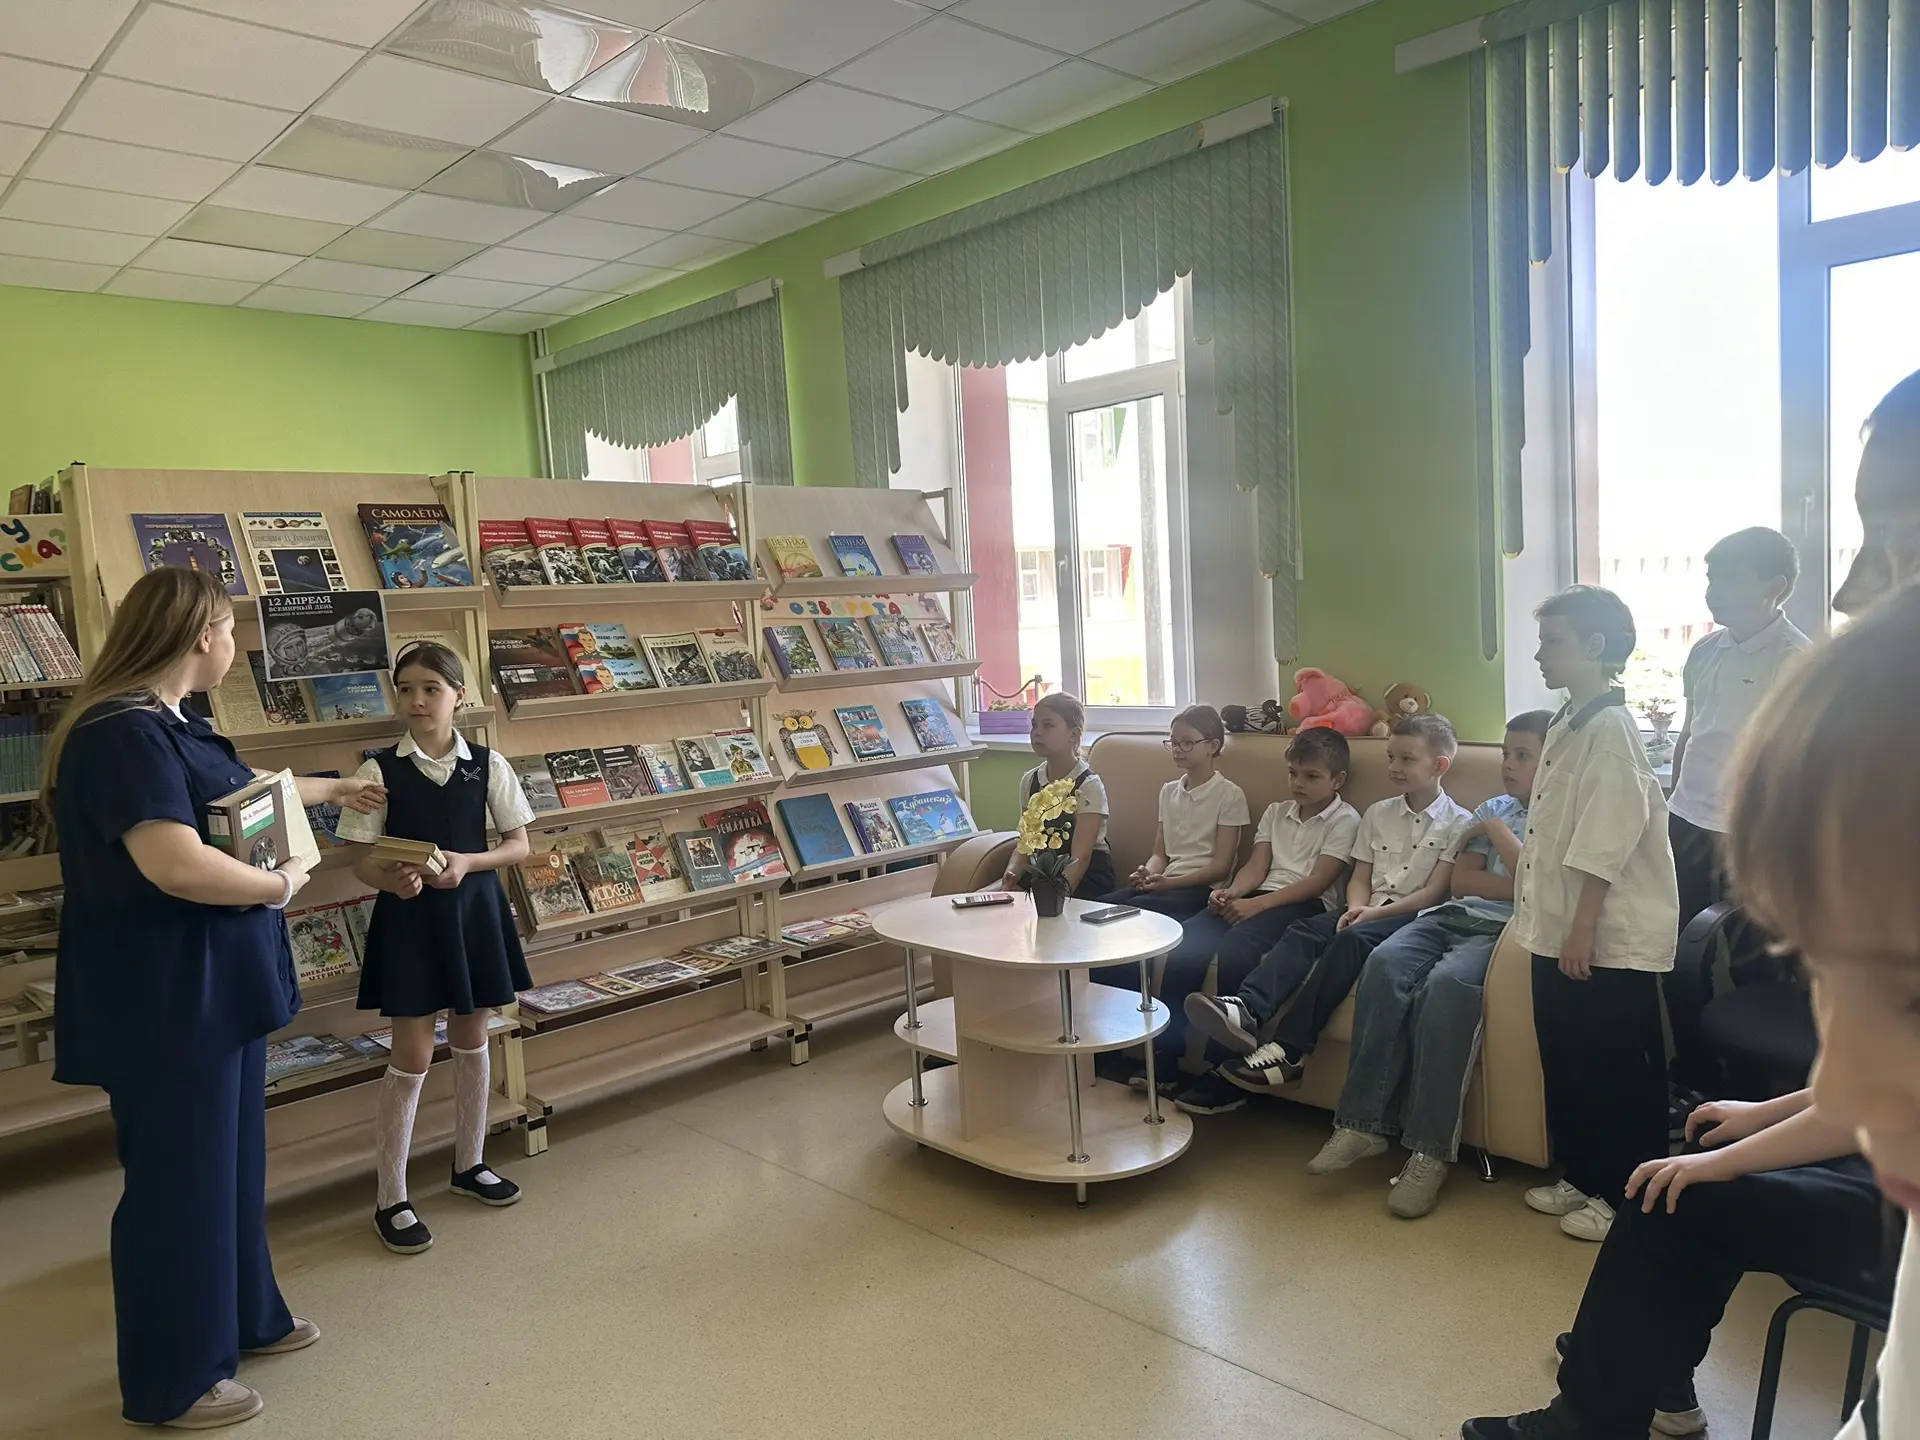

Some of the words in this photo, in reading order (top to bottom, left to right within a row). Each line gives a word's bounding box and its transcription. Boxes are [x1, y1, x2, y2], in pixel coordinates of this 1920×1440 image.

[371, 508, 444, 519] САМОЛЁТЫ
[771, 538, 806, 547] ВЕЧНАЯ
[833, 538, 866, 547] ВЕЧНАЯ
[267, 598, 281, 606] 12
[285, 595, 331, 606] АПРЕЛЯ
[268, 604, 312, 612] ВСЕМИРНЫЙ
[898, 795, 952, 811] Кубанская
[716, 815, 762, 835] ЗЕМЛЯНКА
[588, 880, 634, 903] МОСКВА
[608, 895, 637, 908] НАМИ
[300, 961, 352, 979] ВНЕКЛАССНОЕ
[308, 968, 346, 981] ЧТЕНИЕ
